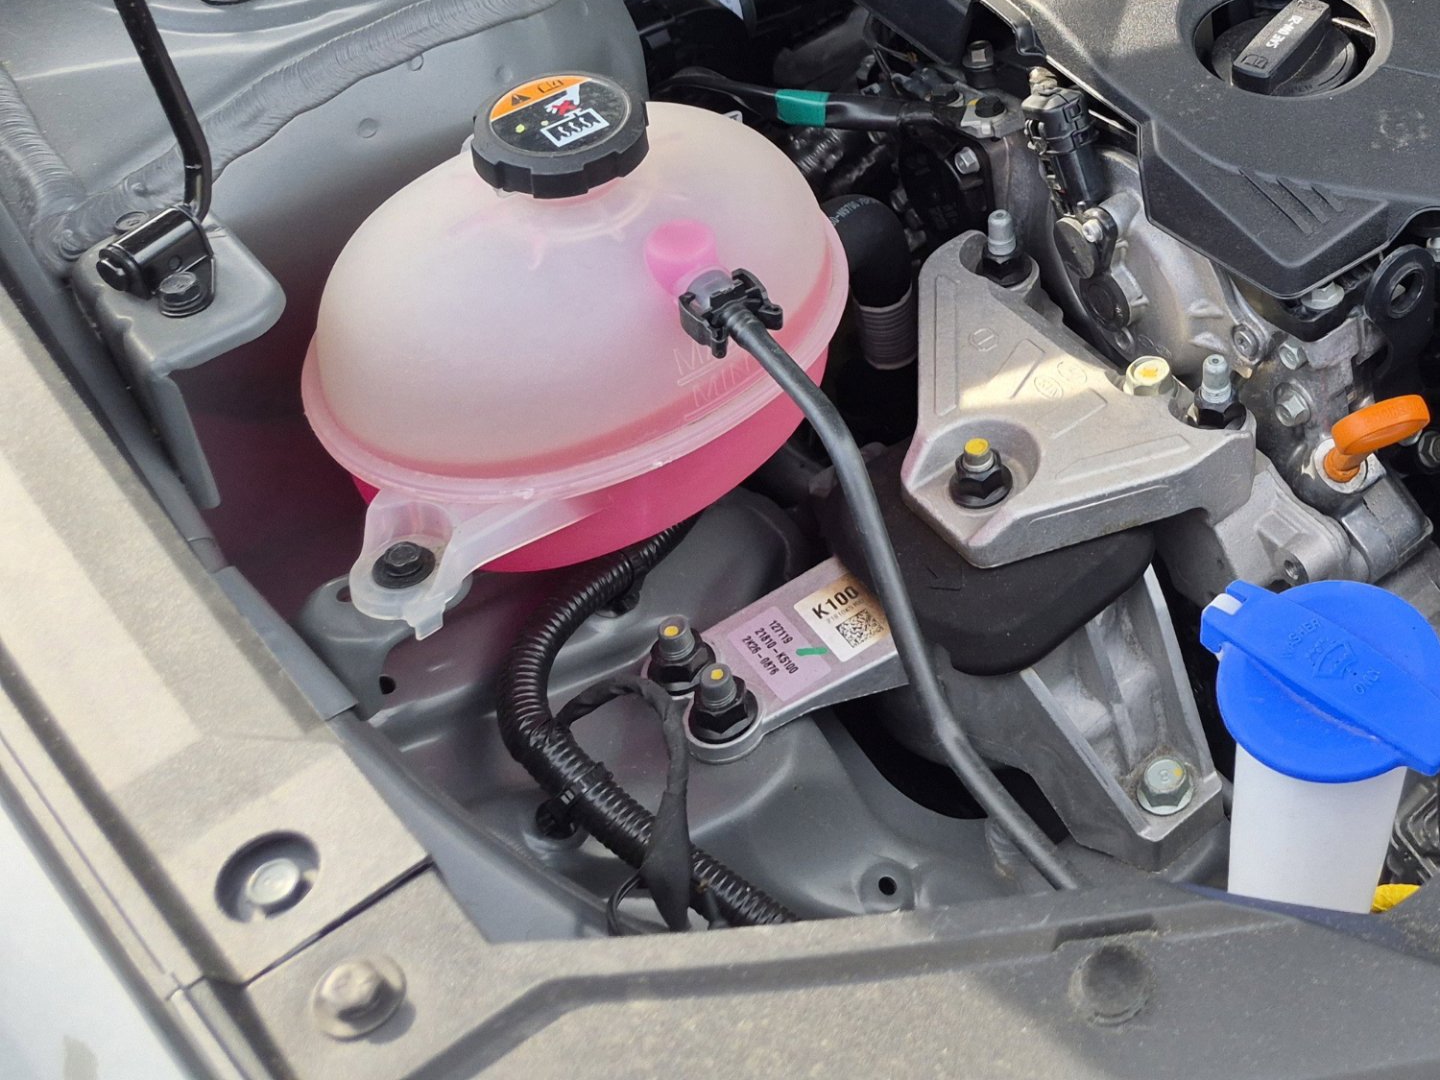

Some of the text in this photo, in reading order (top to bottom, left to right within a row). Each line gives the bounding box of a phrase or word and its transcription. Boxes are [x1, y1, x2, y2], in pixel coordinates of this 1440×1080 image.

[1265, 33, 1286, 49] SAE
[811, 584, 860, 620] K100
[768, 619, 794, 645] 127119
